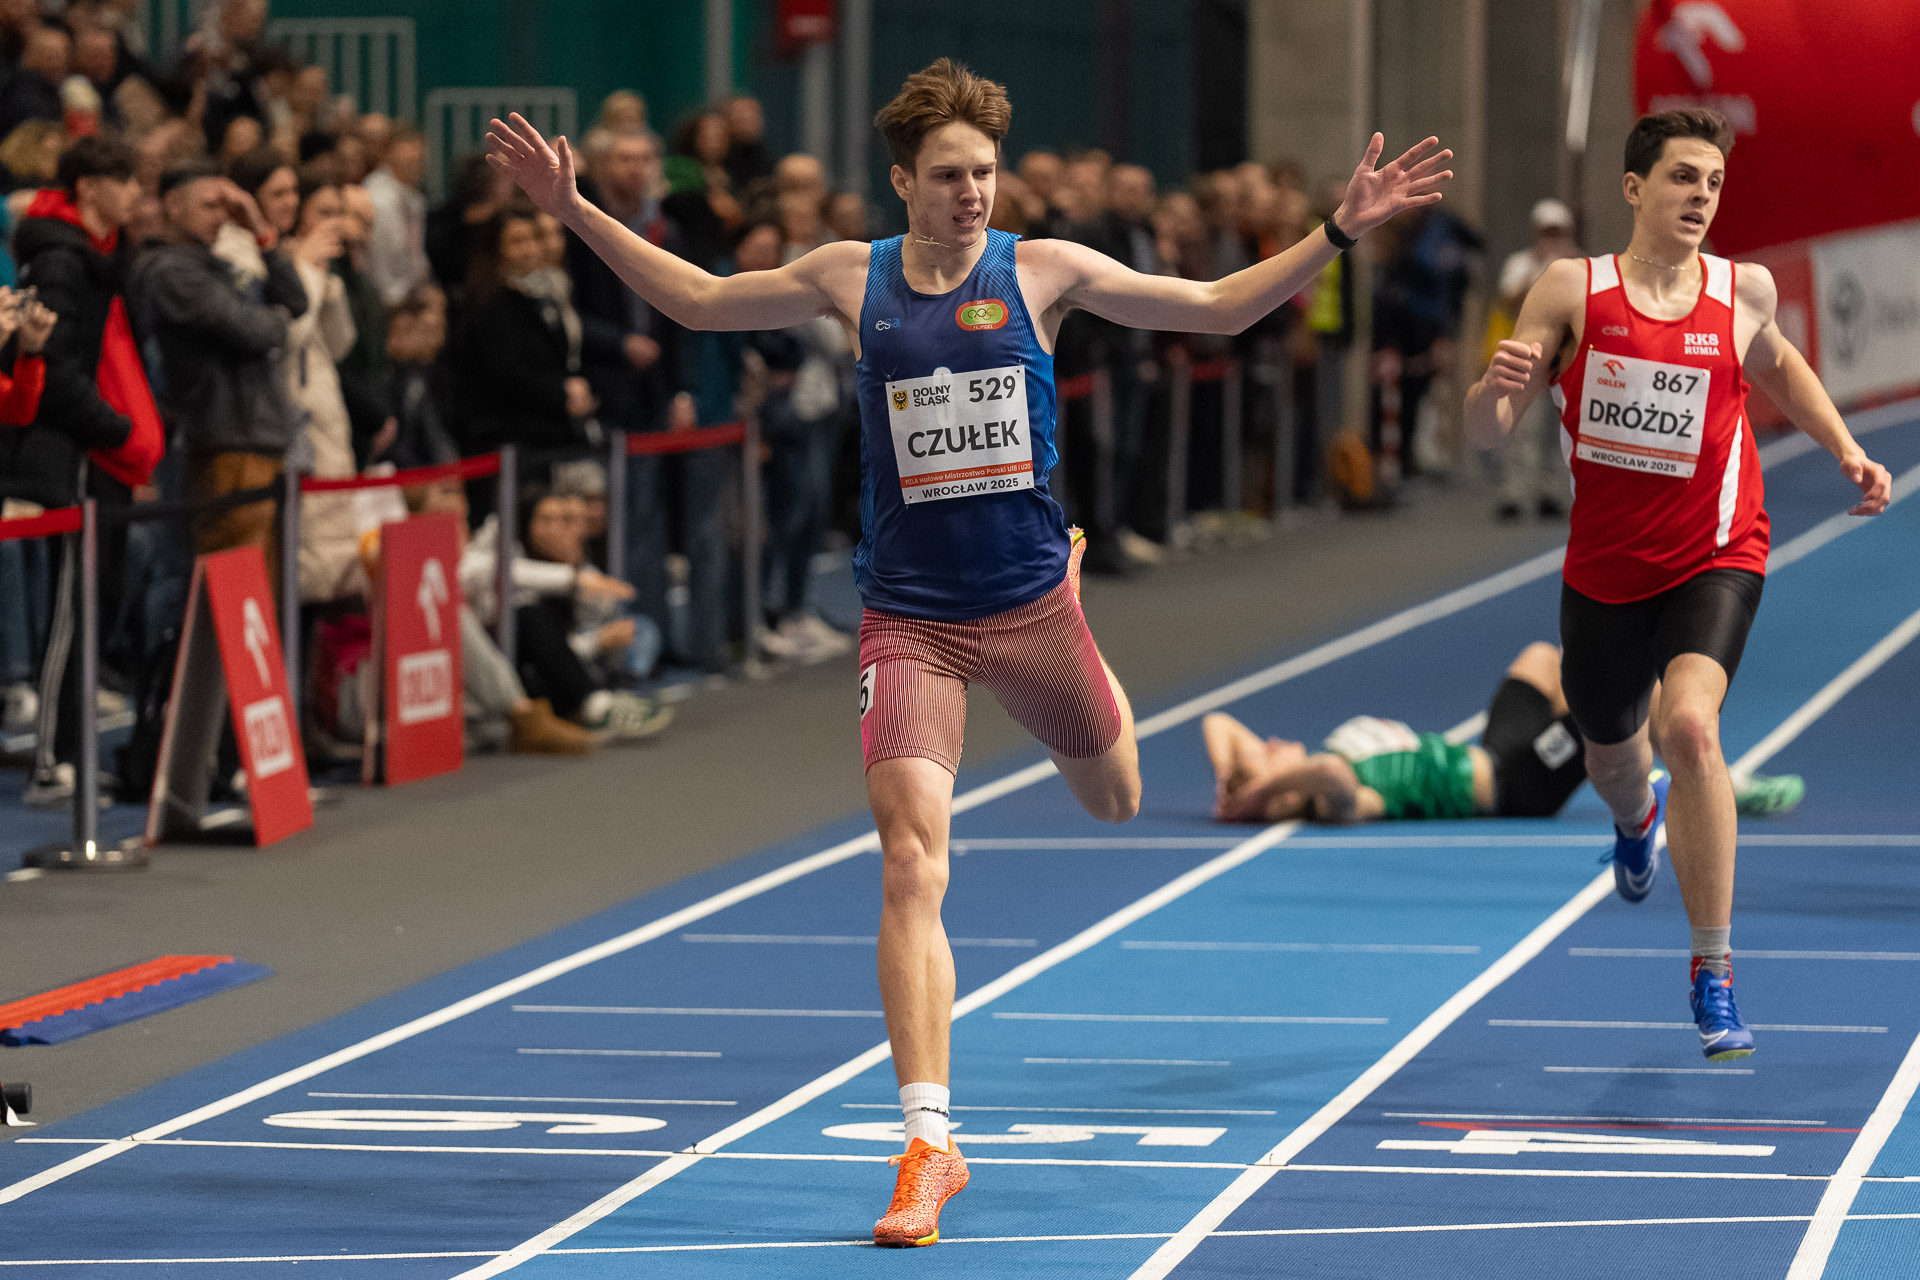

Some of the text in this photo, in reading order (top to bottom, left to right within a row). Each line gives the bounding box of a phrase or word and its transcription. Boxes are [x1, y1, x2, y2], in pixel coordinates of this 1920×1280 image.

[1684, 333, 1719, 346] RKS
[1684, 346, 1720, 356] RUMIA
[912, 384, 951, 397] DOLNY
[969, 375, 1016, 403] 529
[1597, 377, 1626, 390] ORLEN
[1652, 370, 1699, 395] 867
[1588, 398, 1695, 438] DRÓŻDŻ
[907, 418, 1021, 458] CZUŁEK
[944, 468, 986, 480] Mistrzostwa
[986, 465, 1007, 475] Polski
[1591, 450, 1677, 473] WROCŁAW 2025
[922, 477, 1019, 499] WROCŁAW 2025
